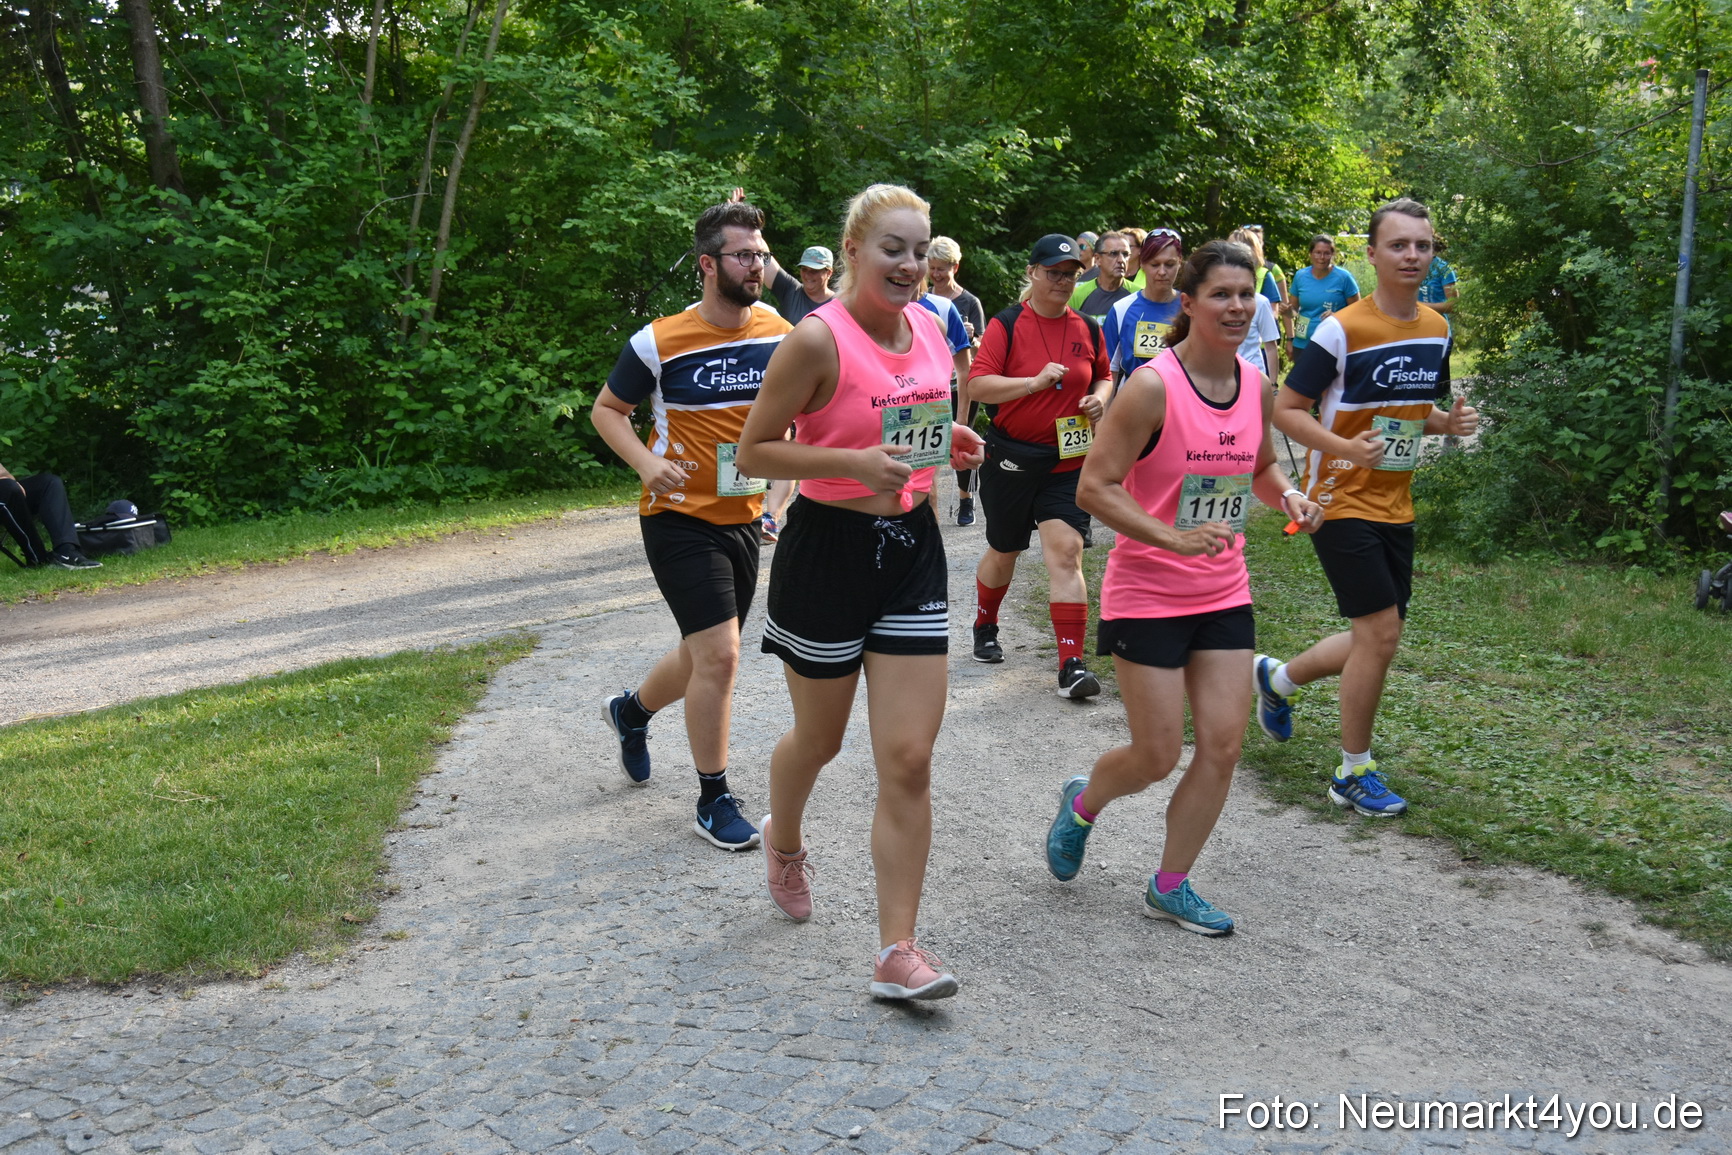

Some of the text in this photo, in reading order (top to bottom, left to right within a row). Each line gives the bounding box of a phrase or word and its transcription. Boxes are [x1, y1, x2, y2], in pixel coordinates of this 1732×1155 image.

[895, 374, 918, 389] Die
[1388, 367, 1438, 384] Fischer
[1393, 383, 1435, 391] AUTOMOBILE
[891, 425, 943, 450] 1115
[1219, 431, 1236, 446] Die
[913, 450, 939, 459] Franziska
[1384, 437, 1414, 457] 762
[1189, 496, 1242, 519] 1118
[918, 600, 947, 611] adidas
